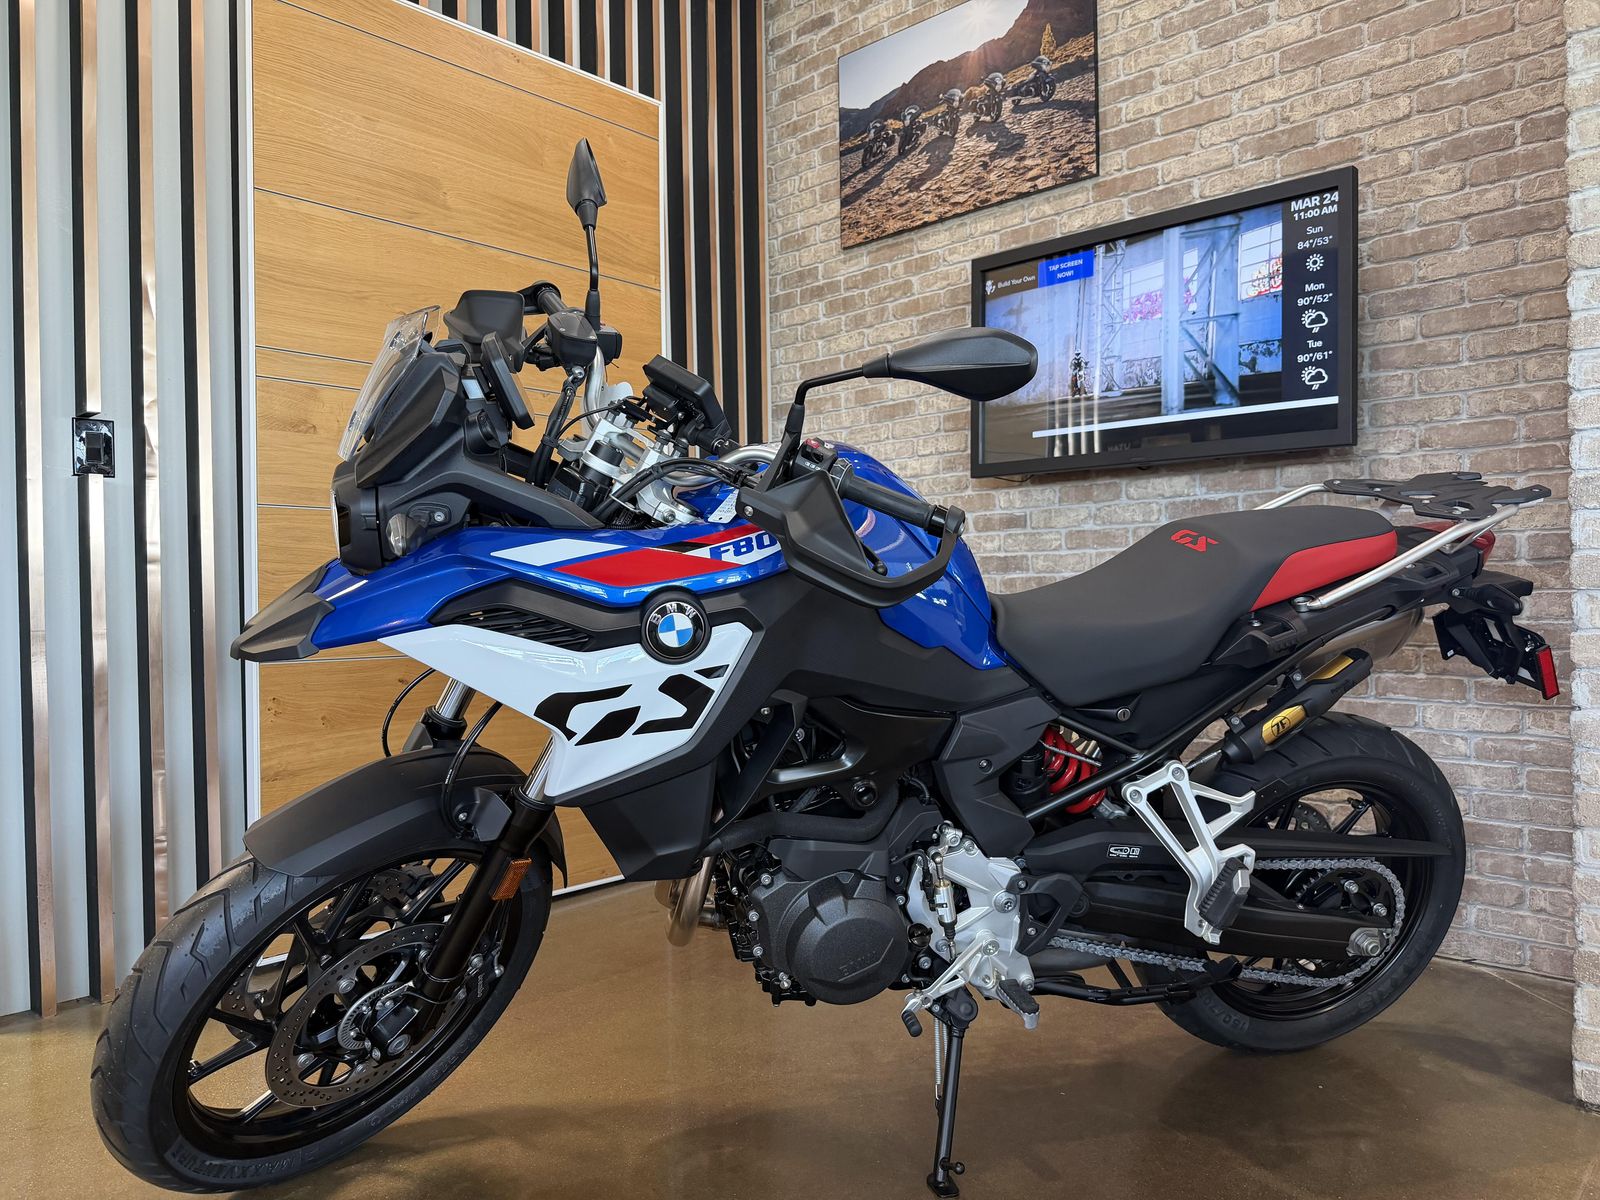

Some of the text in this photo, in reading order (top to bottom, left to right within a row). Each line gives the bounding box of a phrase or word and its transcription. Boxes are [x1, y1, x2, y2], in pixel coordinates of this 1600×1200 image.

[1291, 191, 1339, 211] MAR 24
[1293, 204, 1338, 221] 11:00 AM
[1306, 226, 1323, 235] Sun
[1049, 259, 1083, 272] TAP SCREEN
[997, 275, 1036, 289] Build Your Own
[1305, 283, 1325, 292] Mon
[1307, 340, 1323, 348] Tue
[650, 602, 697, 625] BMW
